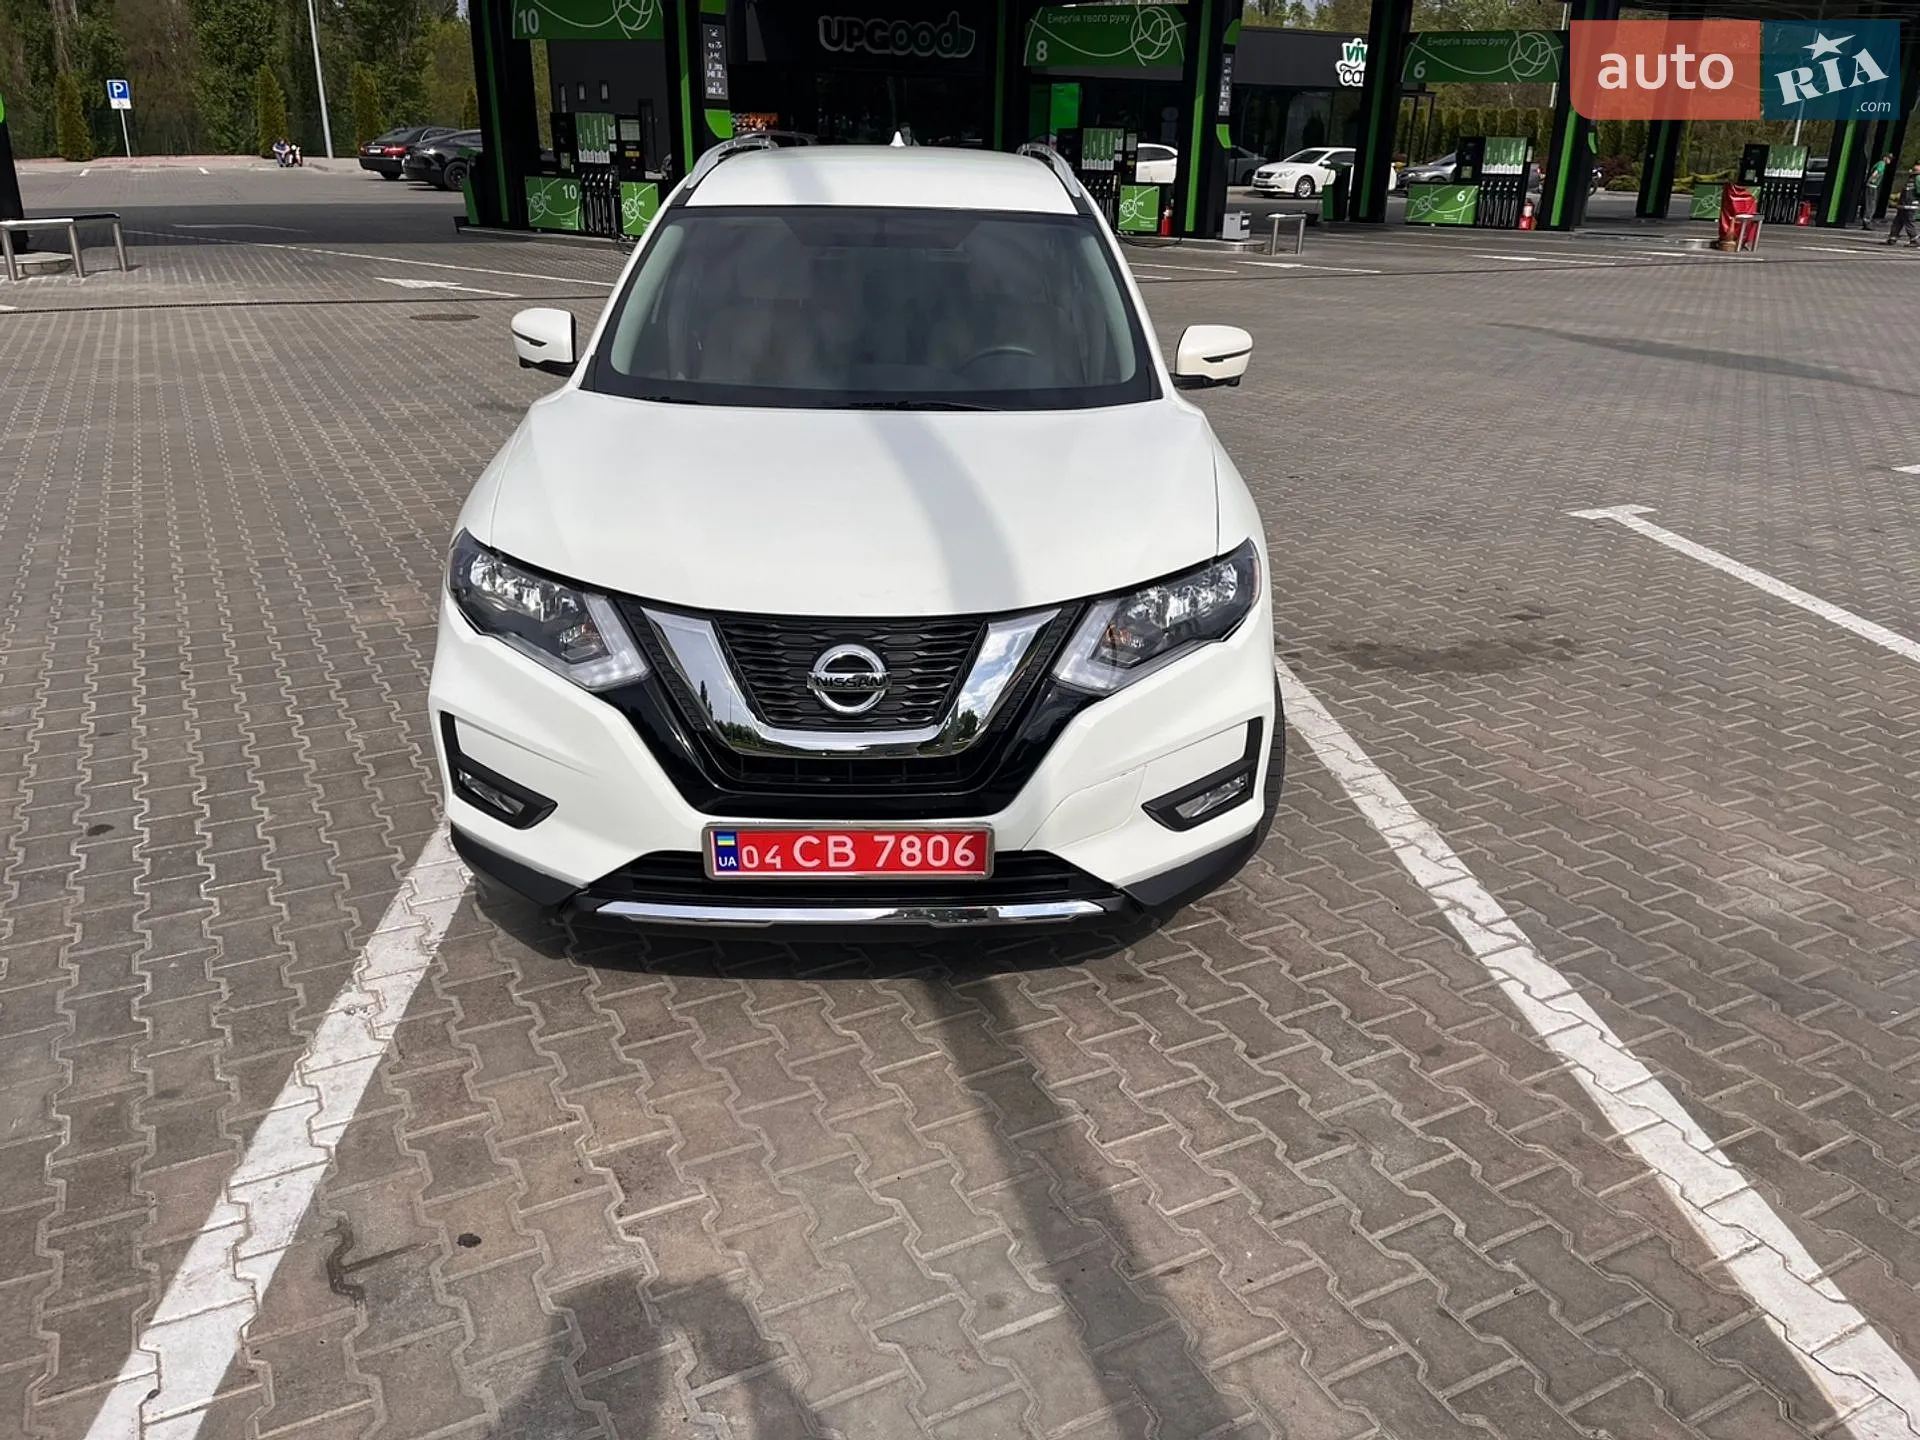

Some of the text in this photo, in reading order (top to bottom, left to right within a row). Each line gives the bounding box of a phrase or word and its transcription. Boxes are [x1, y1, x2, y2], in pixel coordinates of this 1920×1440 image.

[518, 8, 540, 35] 10
[1036, 39, 1048, 62] 8
[1413, 60, 1426, 79] 6
[112, 82, 124, 98] P
[562, 184, 578, 200] 10
[1457, 190, 1466, 202] 6
[814, 675, 885, 687] NISSAN
[742, 834, 977, 869] 04 CB 7806
[718, 856, 737, 868] UA
